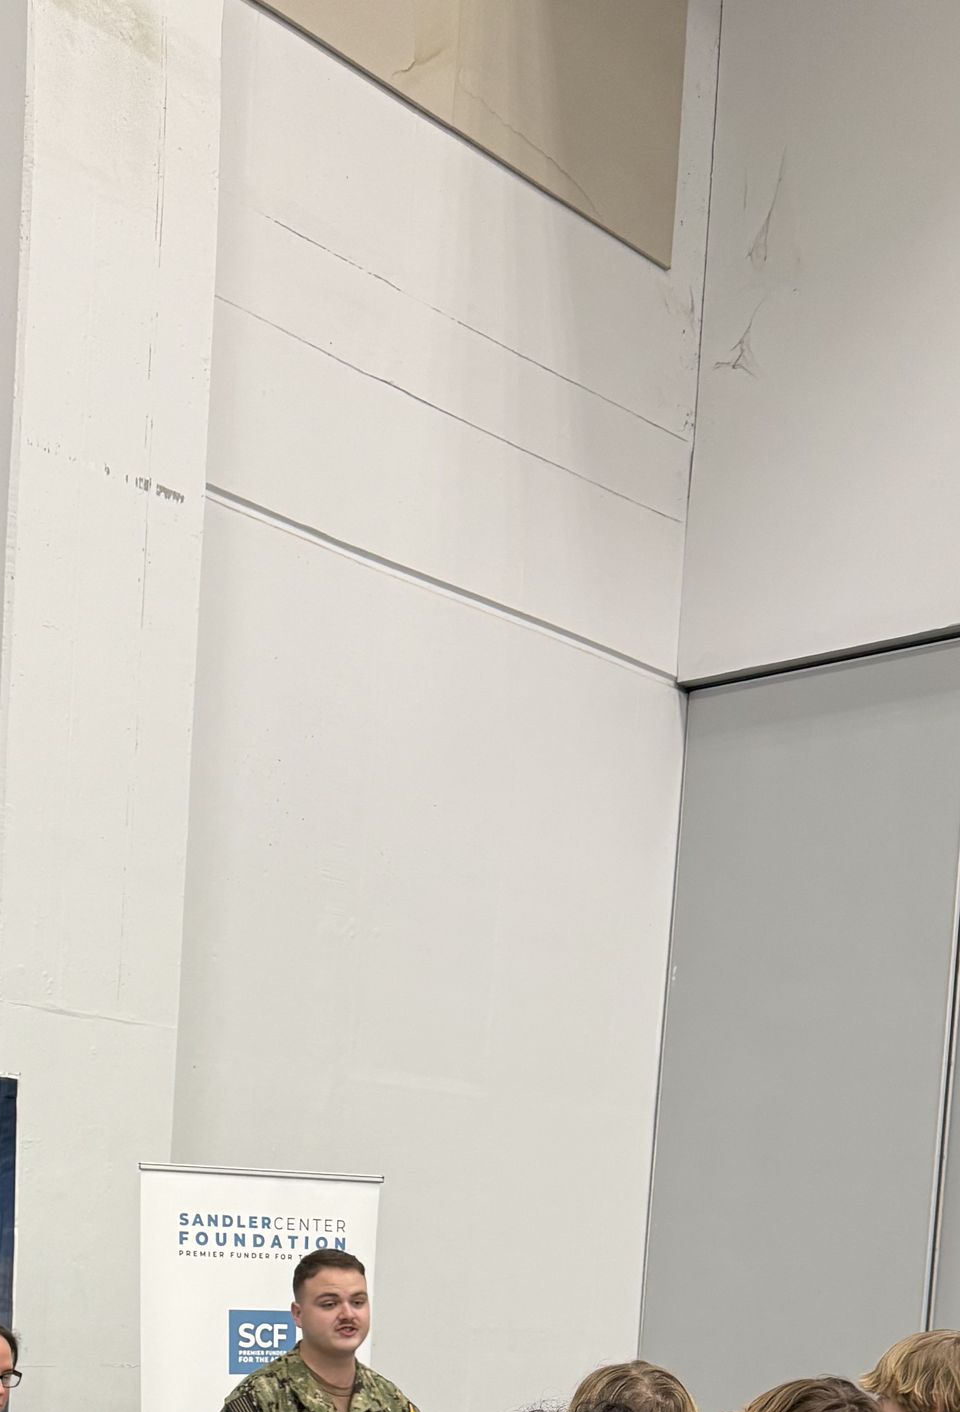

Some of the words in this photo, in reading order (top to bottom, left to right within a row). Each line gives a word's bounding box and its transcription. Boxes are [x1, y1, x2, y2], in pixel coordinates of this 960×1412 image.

[178, 1231, 347, 1251] FOUNDATION
[178, 1249, 225, 1258] PREMIER
[230, 1251, 270, 1260] FUNDER
[275, 1253, 293, 1261] FOR
[238, 1322, 289, 1349] SCF
